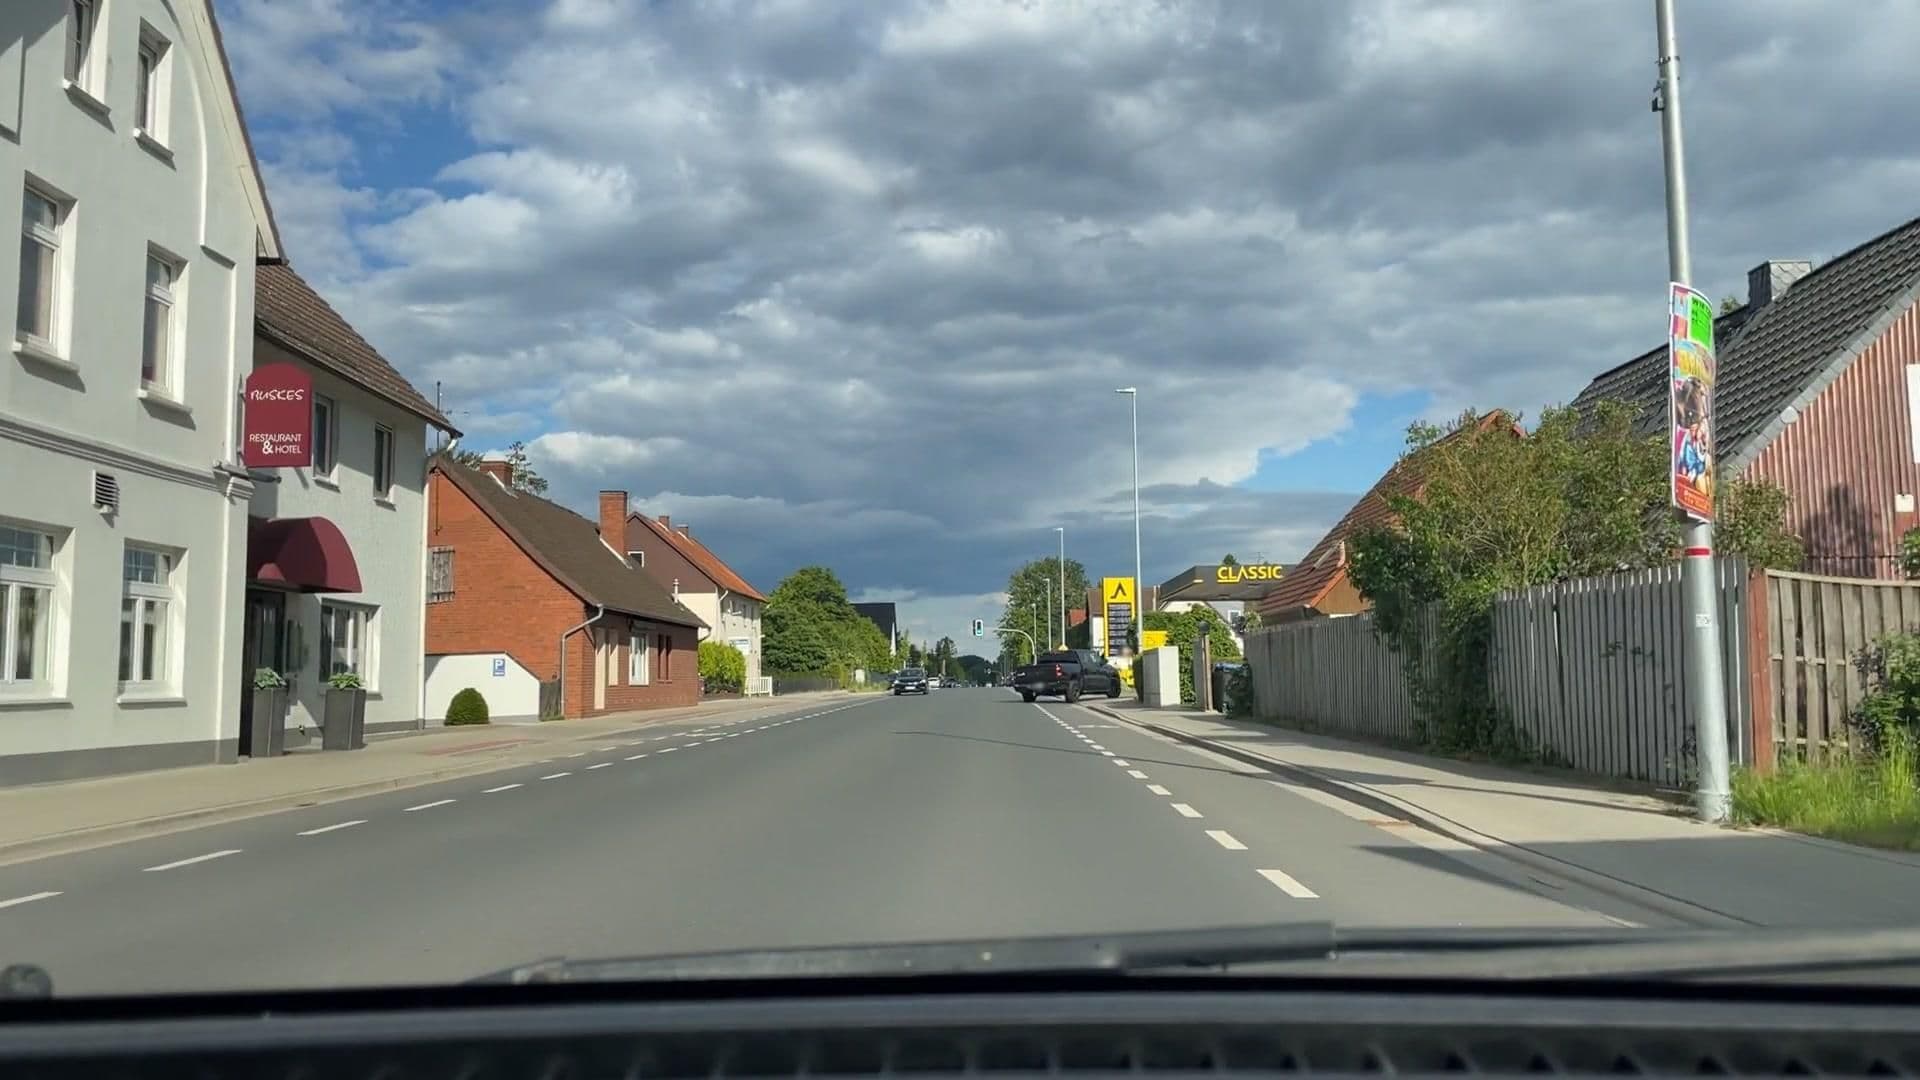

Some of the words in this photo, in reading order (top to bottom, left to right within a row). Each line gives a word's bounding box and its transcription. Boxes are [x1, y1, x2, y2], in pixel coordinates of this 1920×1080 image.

[249, 433, 302, 442] RESTAURANT
[262, 440, 274, 454] &
[275, 445, 302, 454] HOTEL
[1217, 566, 1283, 582] CLASSIC
